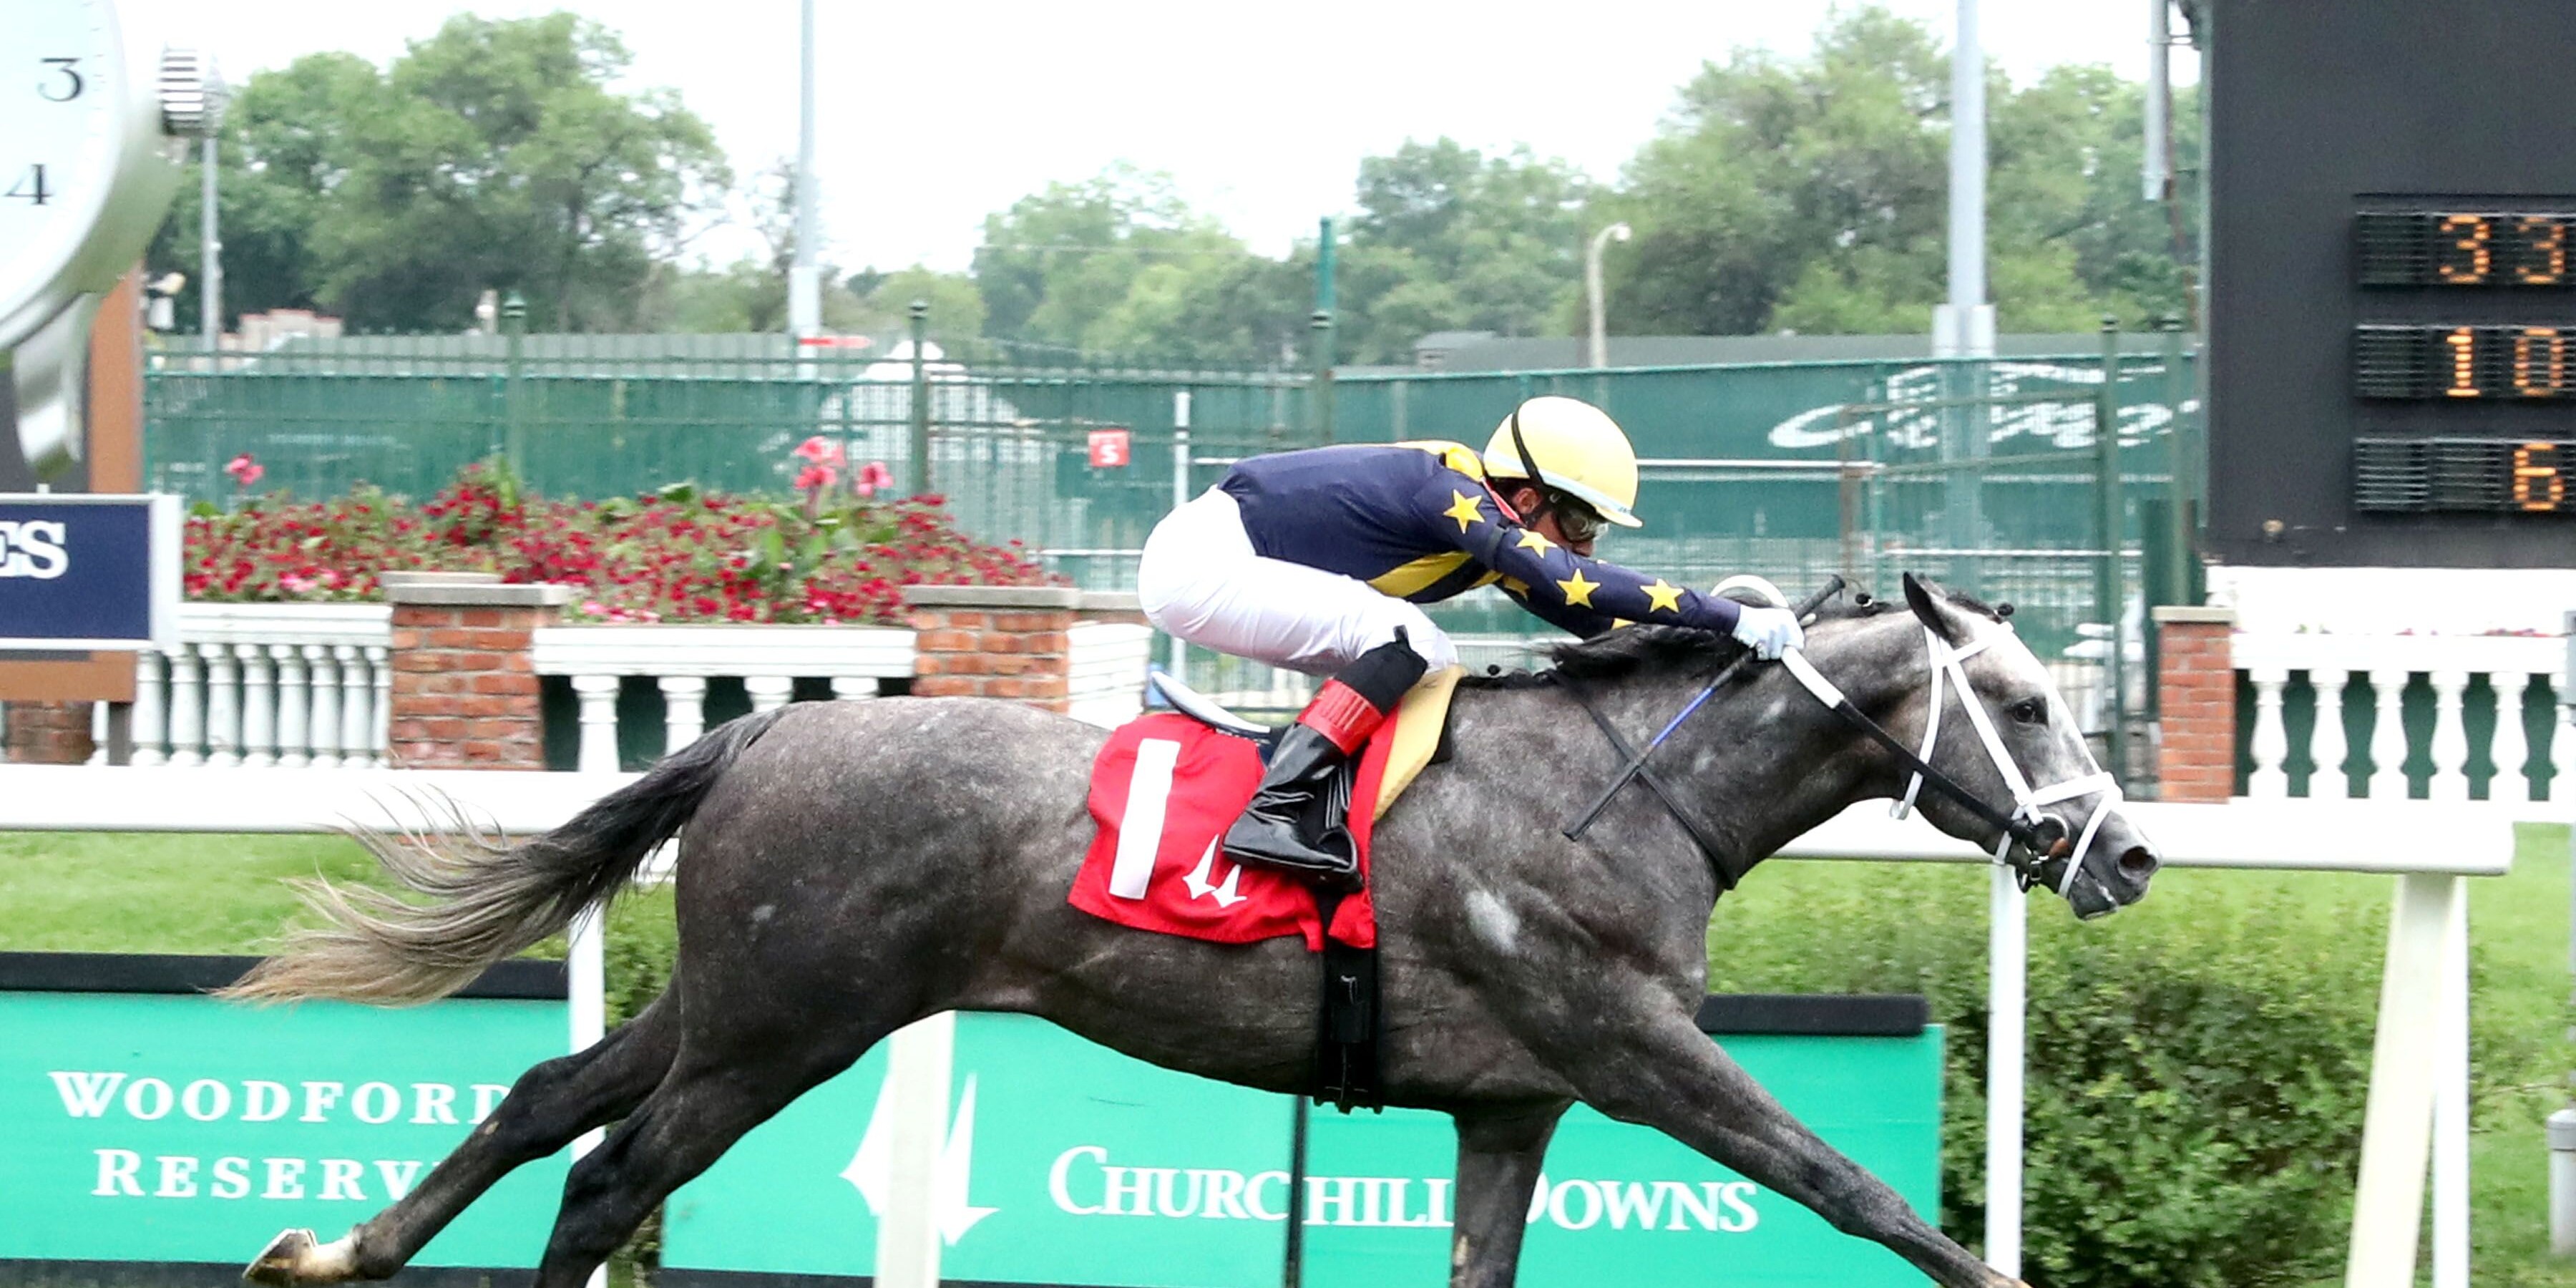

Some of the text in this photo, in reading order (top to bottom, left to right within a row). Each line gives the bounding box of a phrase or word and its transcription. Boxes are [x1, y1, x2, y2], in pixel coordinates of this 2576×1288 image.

[37, 57, 84, 102] 3
[3, 163, 54, 206] 4
[2439, 215, 2565, 284] 33
[2445, 326, 2565, 397] 10
[2513, 441, 2564, 512] 6
[1108, 738, 1181, 900] 1
[48, 1071, 511, 1126] WOODFORD
[91, 1148, 442, 1201] RESERV
[1049, 1146, 1455, 1228] CHURCHILL
